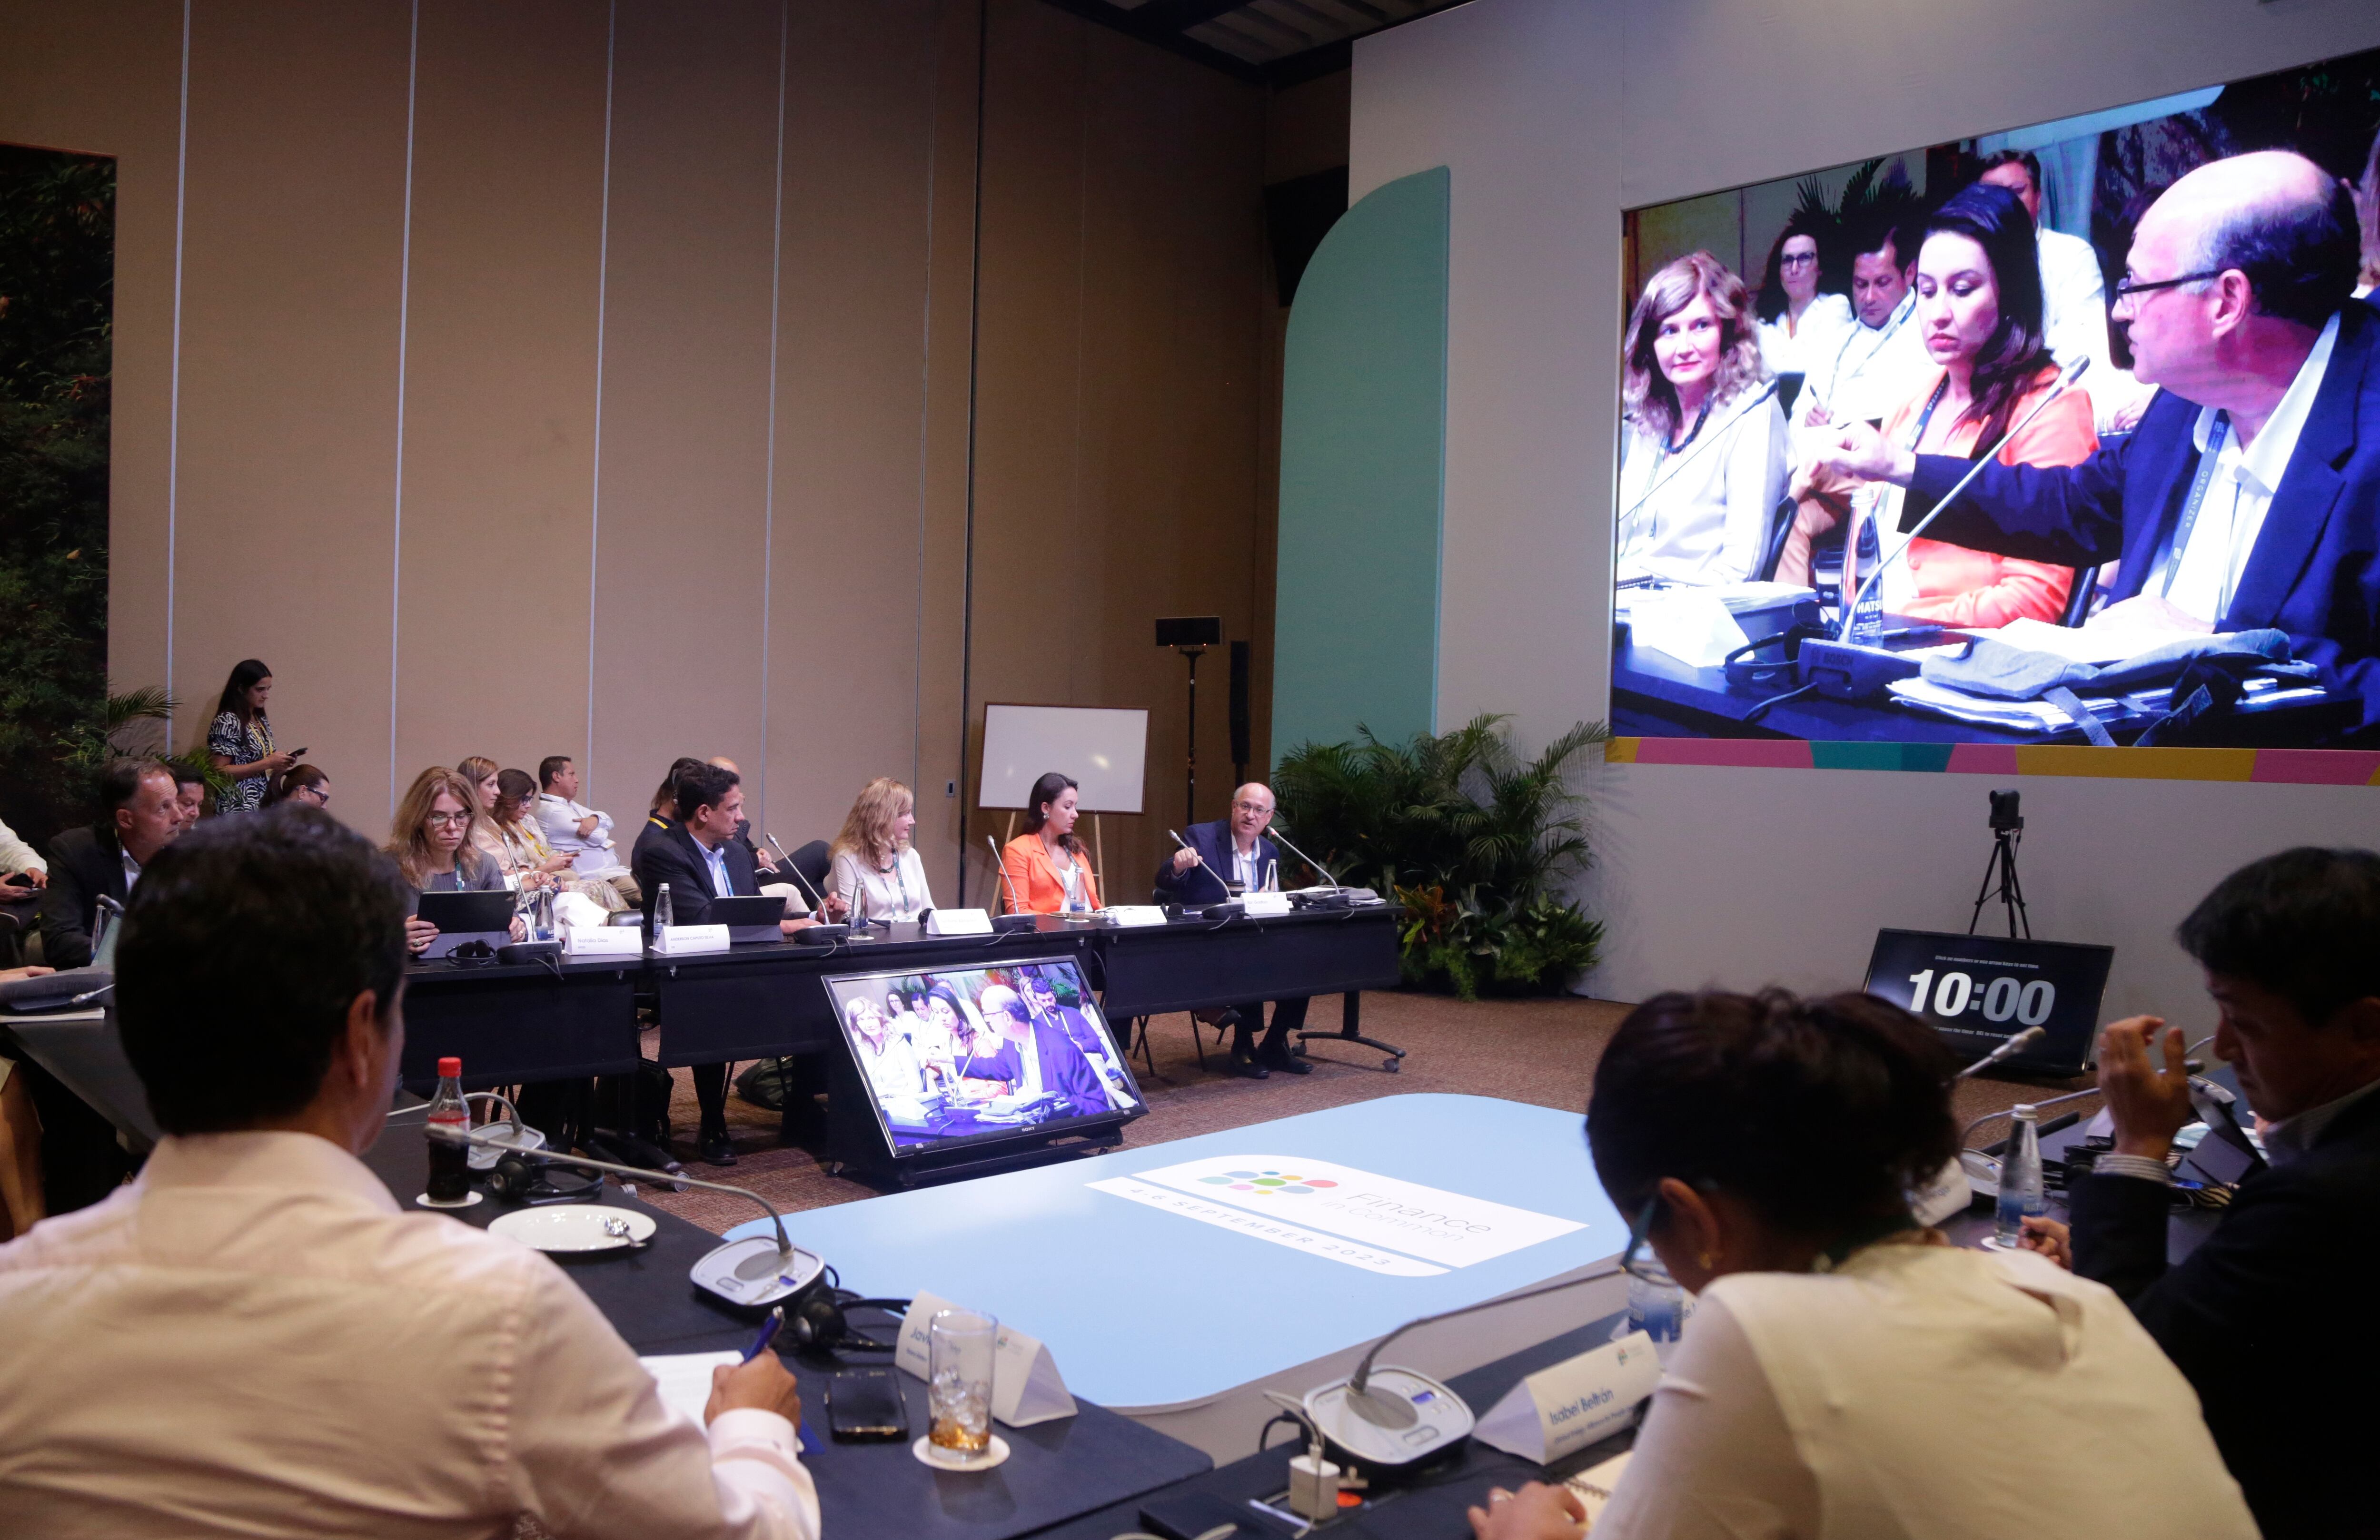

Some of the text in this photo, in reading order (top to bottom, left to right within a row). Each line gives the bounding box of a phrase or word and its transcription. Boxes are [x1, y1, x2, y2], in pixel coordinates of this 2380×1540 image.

[2185, 471, 2209, 528] ORGANIZER
[1909, 969, 2055, 1026] 10:00
[1130, 1189, 1391, 1265] 4-6 SEPTEMBER 2023
[1320, 1200, 1464, 1241] in Common
[1346, 1193, 1491, 1233] Finance
[1550, 1401, 1580, 1425] Isabel
[1580, 1387, 1614, 1412] Beltrán
